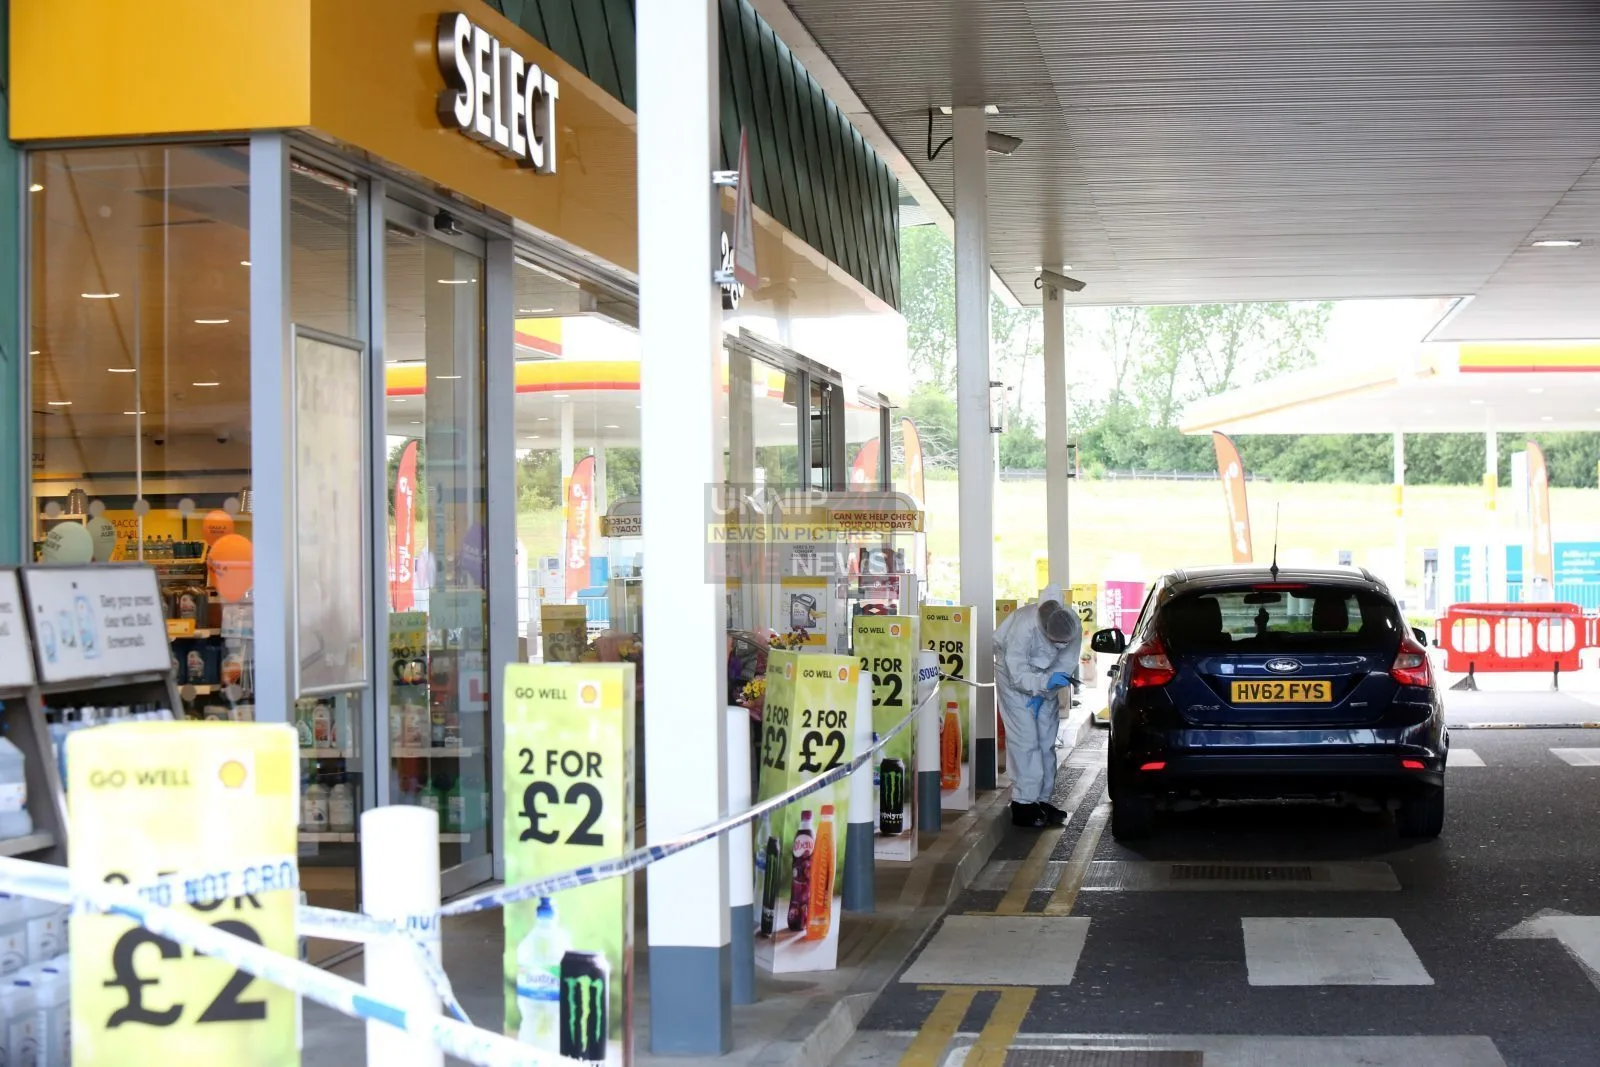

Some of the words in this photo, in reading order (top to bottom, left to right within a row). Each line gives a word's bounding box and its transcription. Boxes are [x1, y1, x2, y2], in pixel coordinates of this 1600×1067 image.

[453, 13, 559, 173] SELECT
[834, 513, 853, 521] CAN
[854, 513, 868, 521] WE
[869, 513, 889, 521] HELP
[890, 513, 917, 521] CHECK
[839, 521, 863, 529] YOUR
[880, 521, 912, 529] TODAY?
[928, 640, 936, 650] 2
[939, 641, 964, 653] FOR
[803, 669, 815, 678] GO
[816, 670, 832, 679] WELL
[860, 657, 869, 671] 2
[873, 658, 903, 672] FOR
[515, 687, 534, 699] GO
[539, 688, 568, 700] WELL
[1237, 684, 1285, 700] HV62
[1289, 684, 1324, 699] FYS
[766, 704, 772, 722] 2
[772, 706, 789, 726] FOR
[802, 709, 812, 728] 2
[817, 710, 848, 729] FOR
[763, 725, 787, 771] £2
[798, 730, 846, 773] £2
[518, 748, 534, 775] 2
[546, 750, 603, 778] FOR
[89, 770, 127, 788] GO
[135, 769, 190, 786] WELL
[518, 781, 604, 846] £2
[242, 861, 297, 893] CRO
[103, 919, 267, 1030] £2
